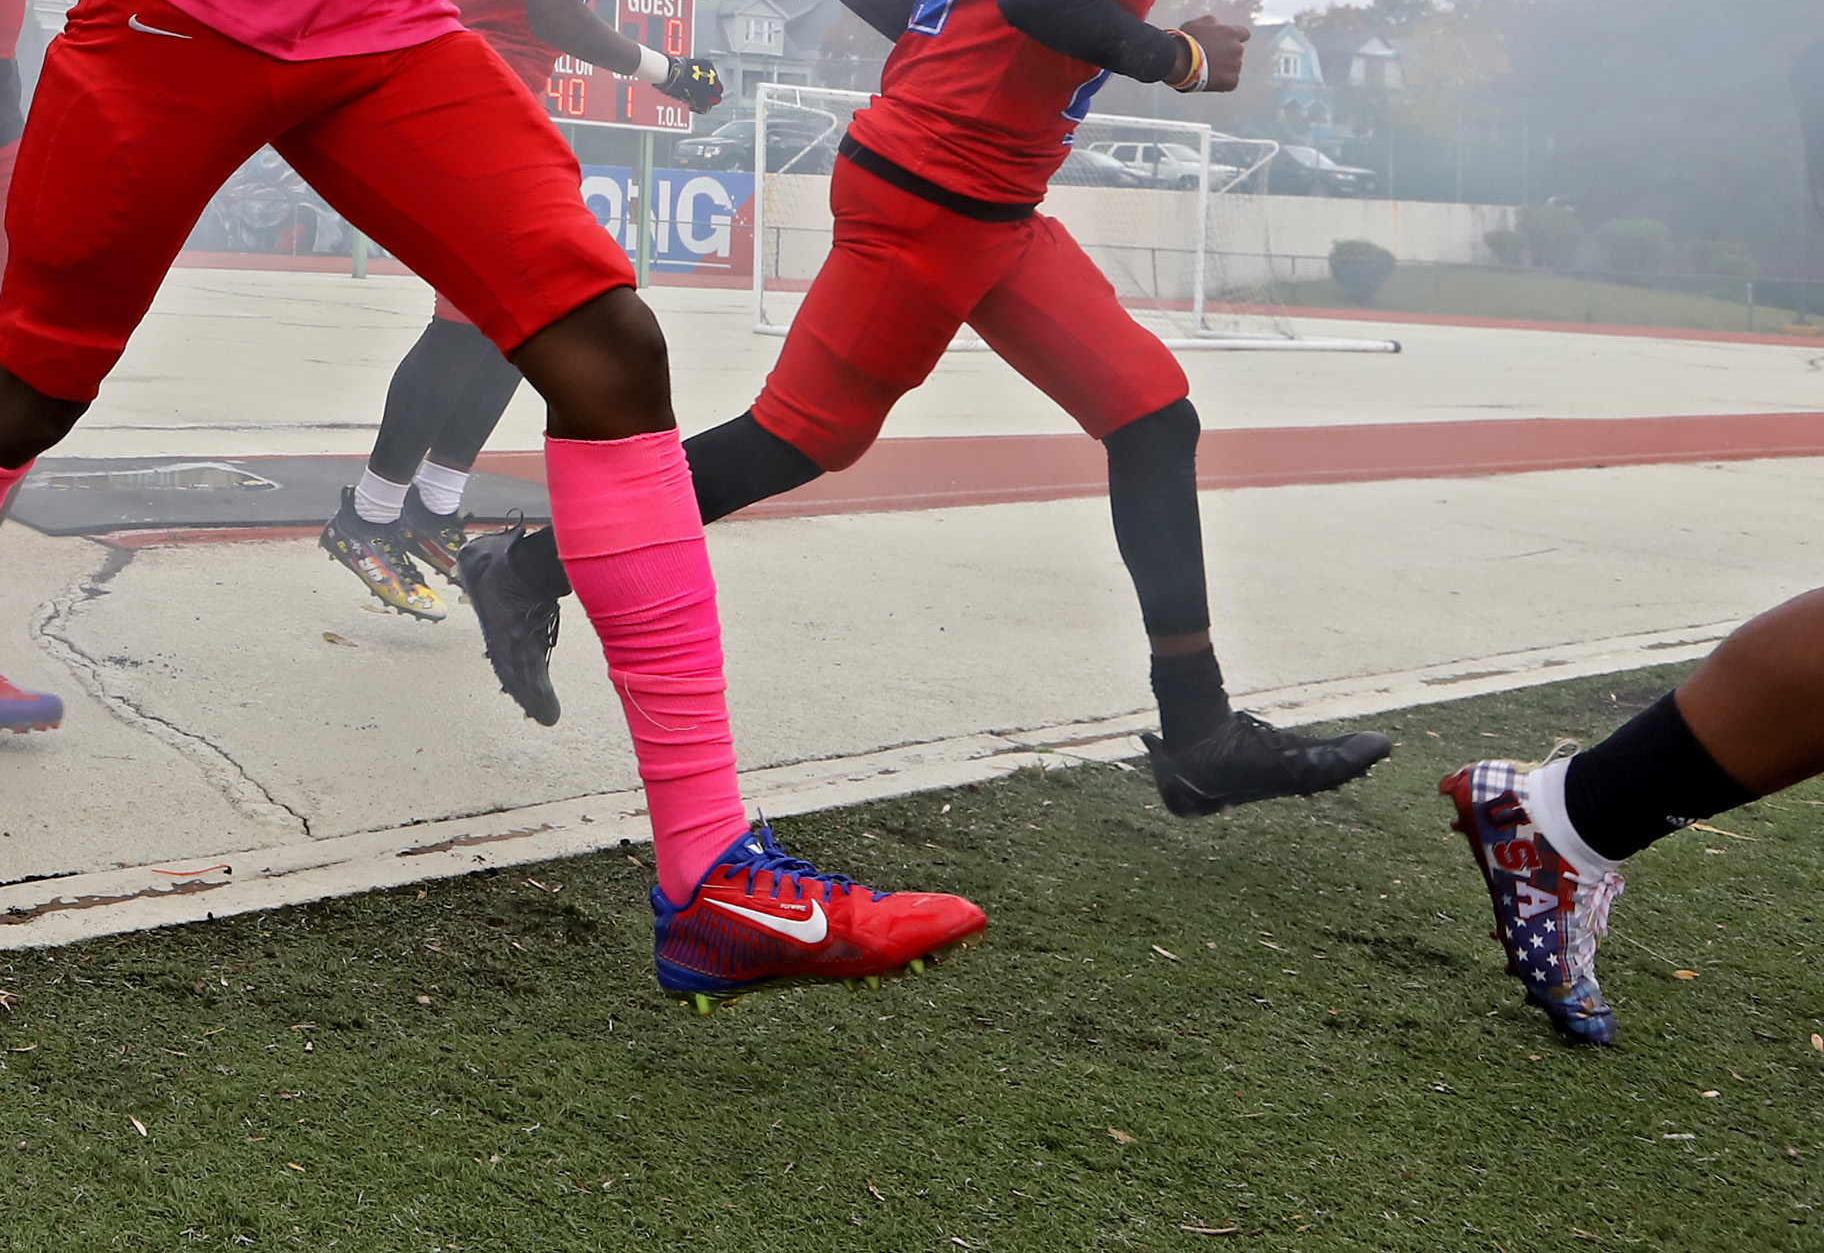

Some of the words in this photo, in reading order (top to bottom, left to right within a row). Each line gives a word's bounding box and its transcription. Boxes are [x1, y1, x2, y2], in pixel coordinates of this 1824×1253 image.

[666, 19, 684, 56] 0
[546, 77, 587, 116] 40
[626, 85, 634, 118] 1
[656, 105, 688, 128] T.O.L.
